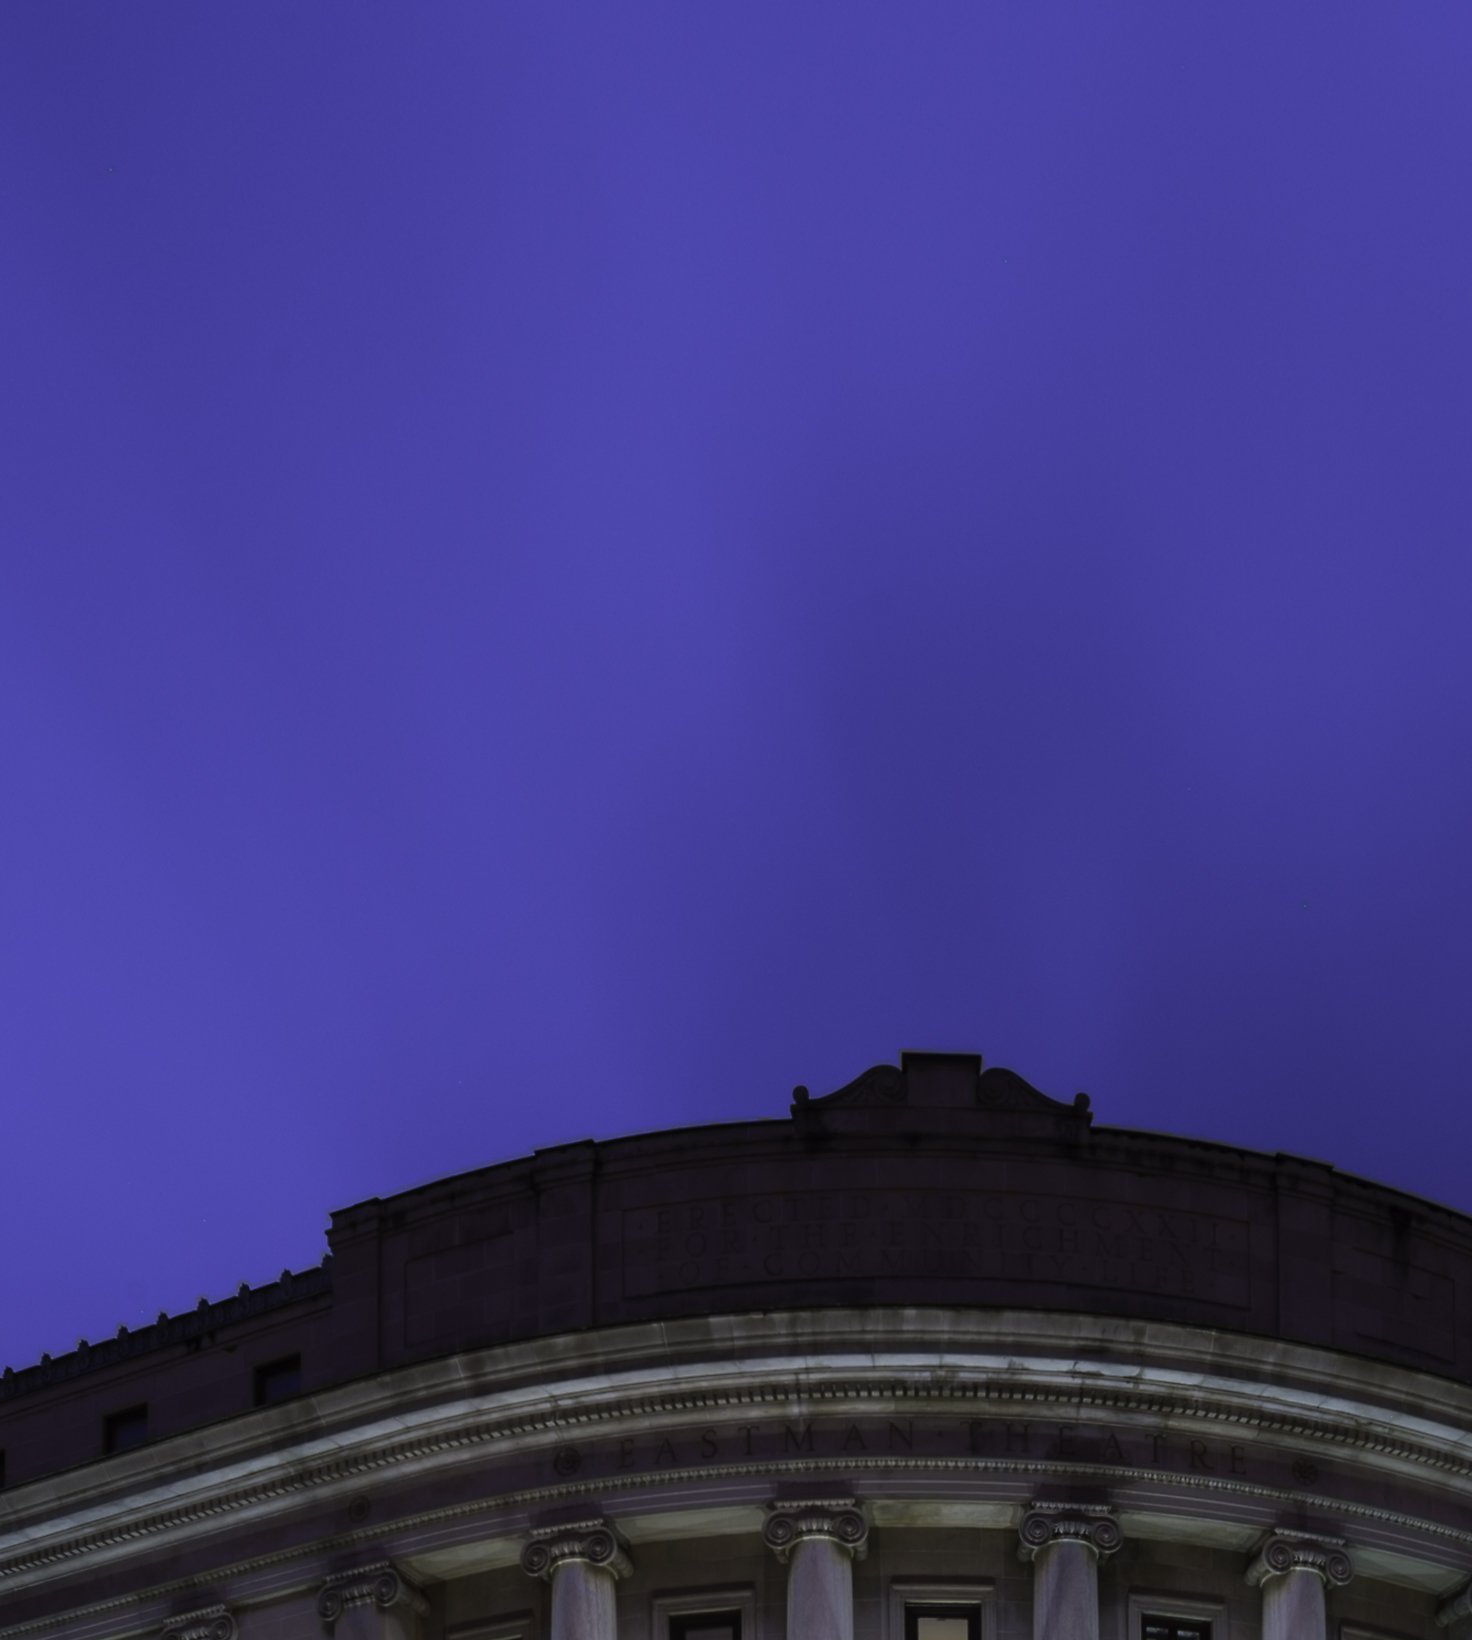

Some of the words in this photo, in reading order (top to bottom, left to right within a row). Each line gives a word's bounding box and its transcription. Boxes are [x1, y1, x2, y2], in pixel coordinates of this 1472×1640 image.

[657, 1195, 871, 1236] ERECTED
[656, 1229, 738, 1262] FOR
[769, 1222, 856, 1252] THE
[889, 1221, 1224, 1272] ENRICHMENT
[678, 1260, 729, 1284] OF
[763, 1249, 1068, 1279] COMMUNITY
[617, 1420, 914, 1470] EASTMAN
[959, 1421, 1248, 1476] THEATRE
